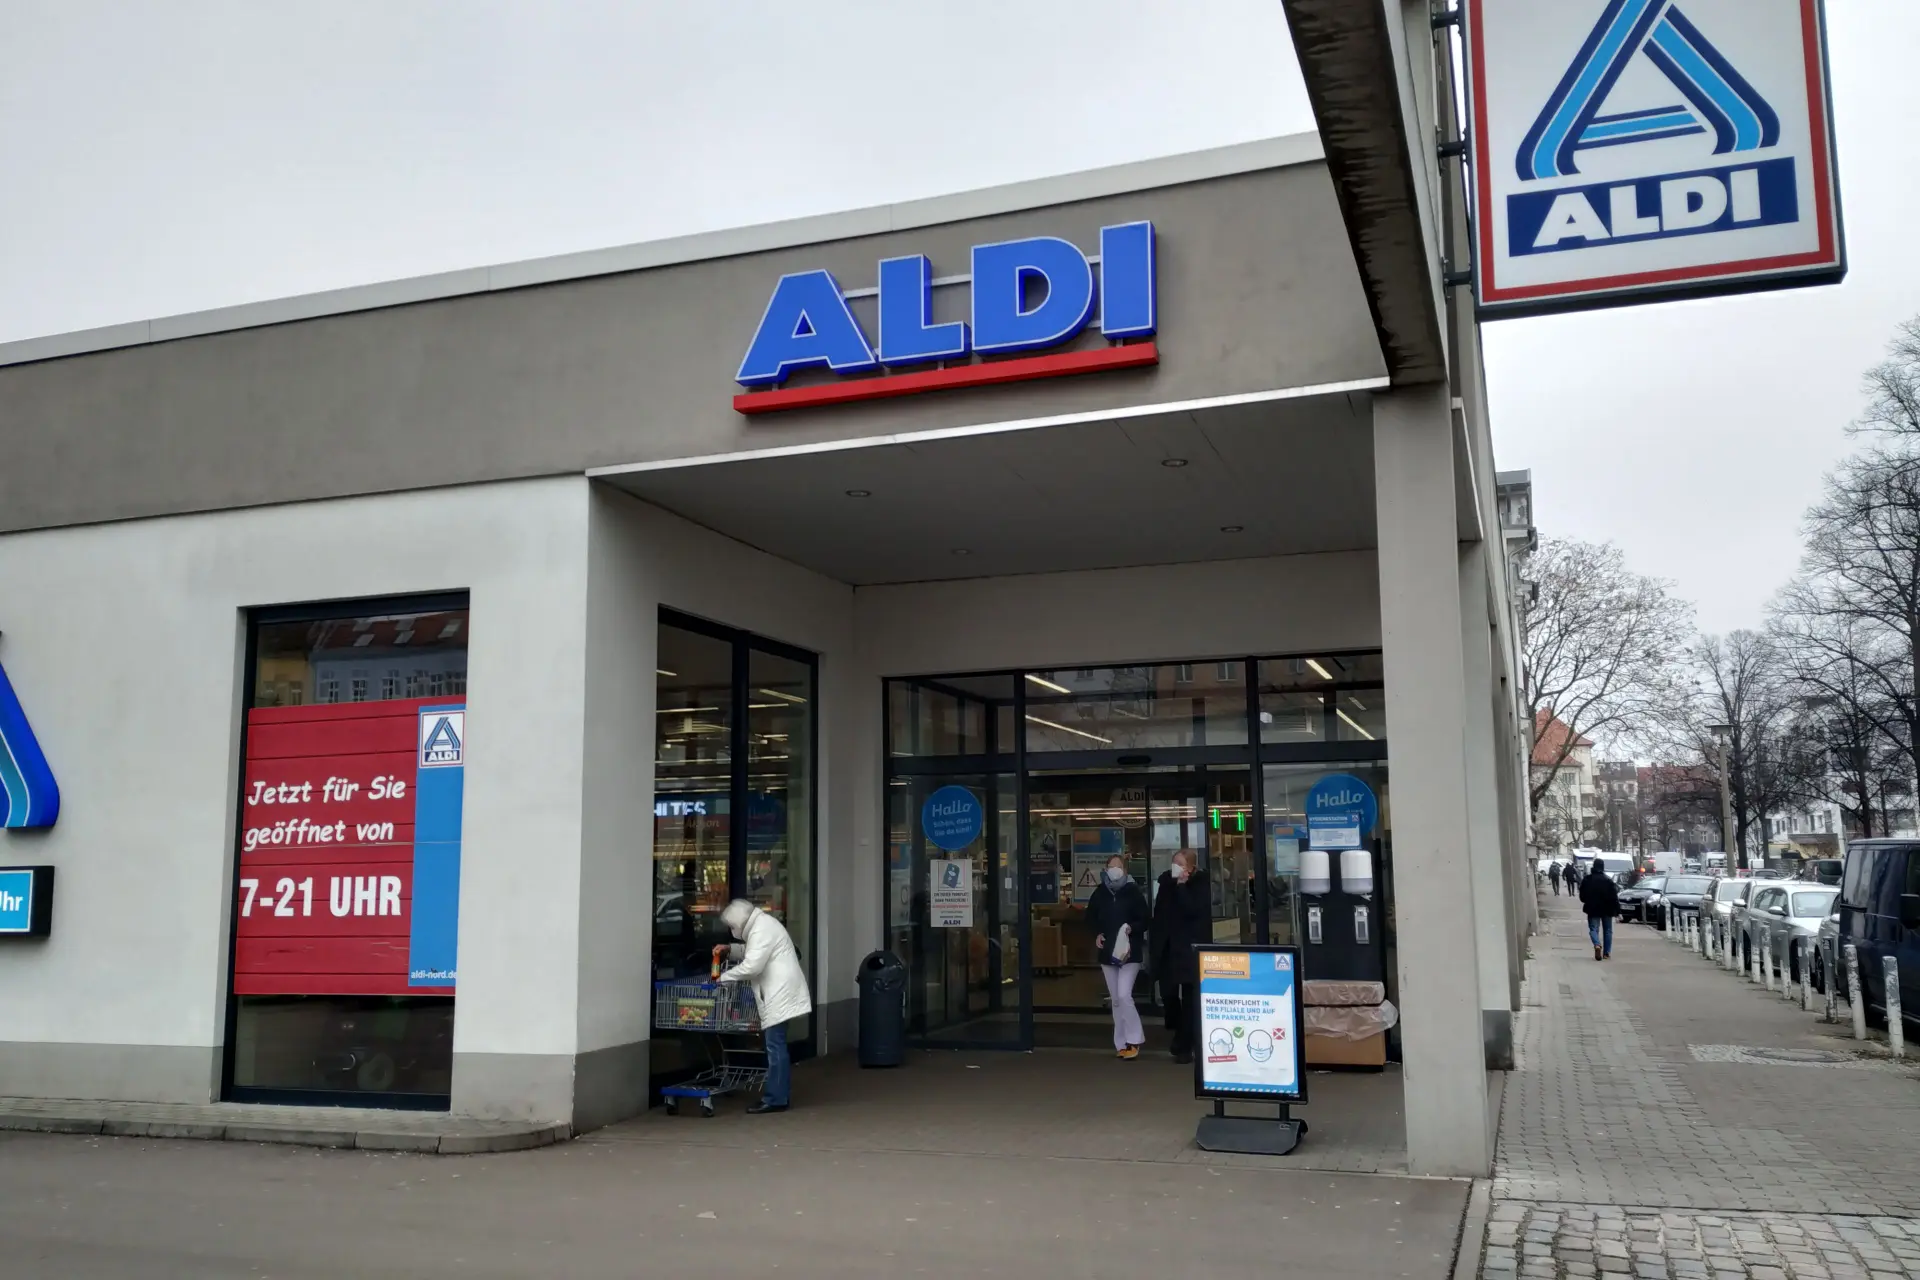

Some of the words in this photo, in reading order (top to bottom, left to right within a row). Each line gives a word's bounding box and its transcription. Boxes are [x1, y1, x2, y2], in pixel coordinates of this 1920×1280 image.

[1532, 168, 1762, 248] ALDI
[735, 220, 1156, 387] ALDI
[427, 751, 458, 762] ALDI
[248, 781, 312, 806] Jetzt
[323, 776, 359, 804] für
[367, 775, 406, 800] Sie
[1120, 791, 1144, 802] ALDI
[1316, 789, 1364, 808] Hallo
[932, 799, 973, 817] Hallo
[244, 818, 346, 852] geöffnet
[356, 822, 394, 841] von
[240, 877, 313, 917] 7-21
[330, 875, 402, 917] UHR
[411, 969, 457, 979] aldi-nord.de
[1206, 998, 1260, 1006] MASKENPFLICHT
